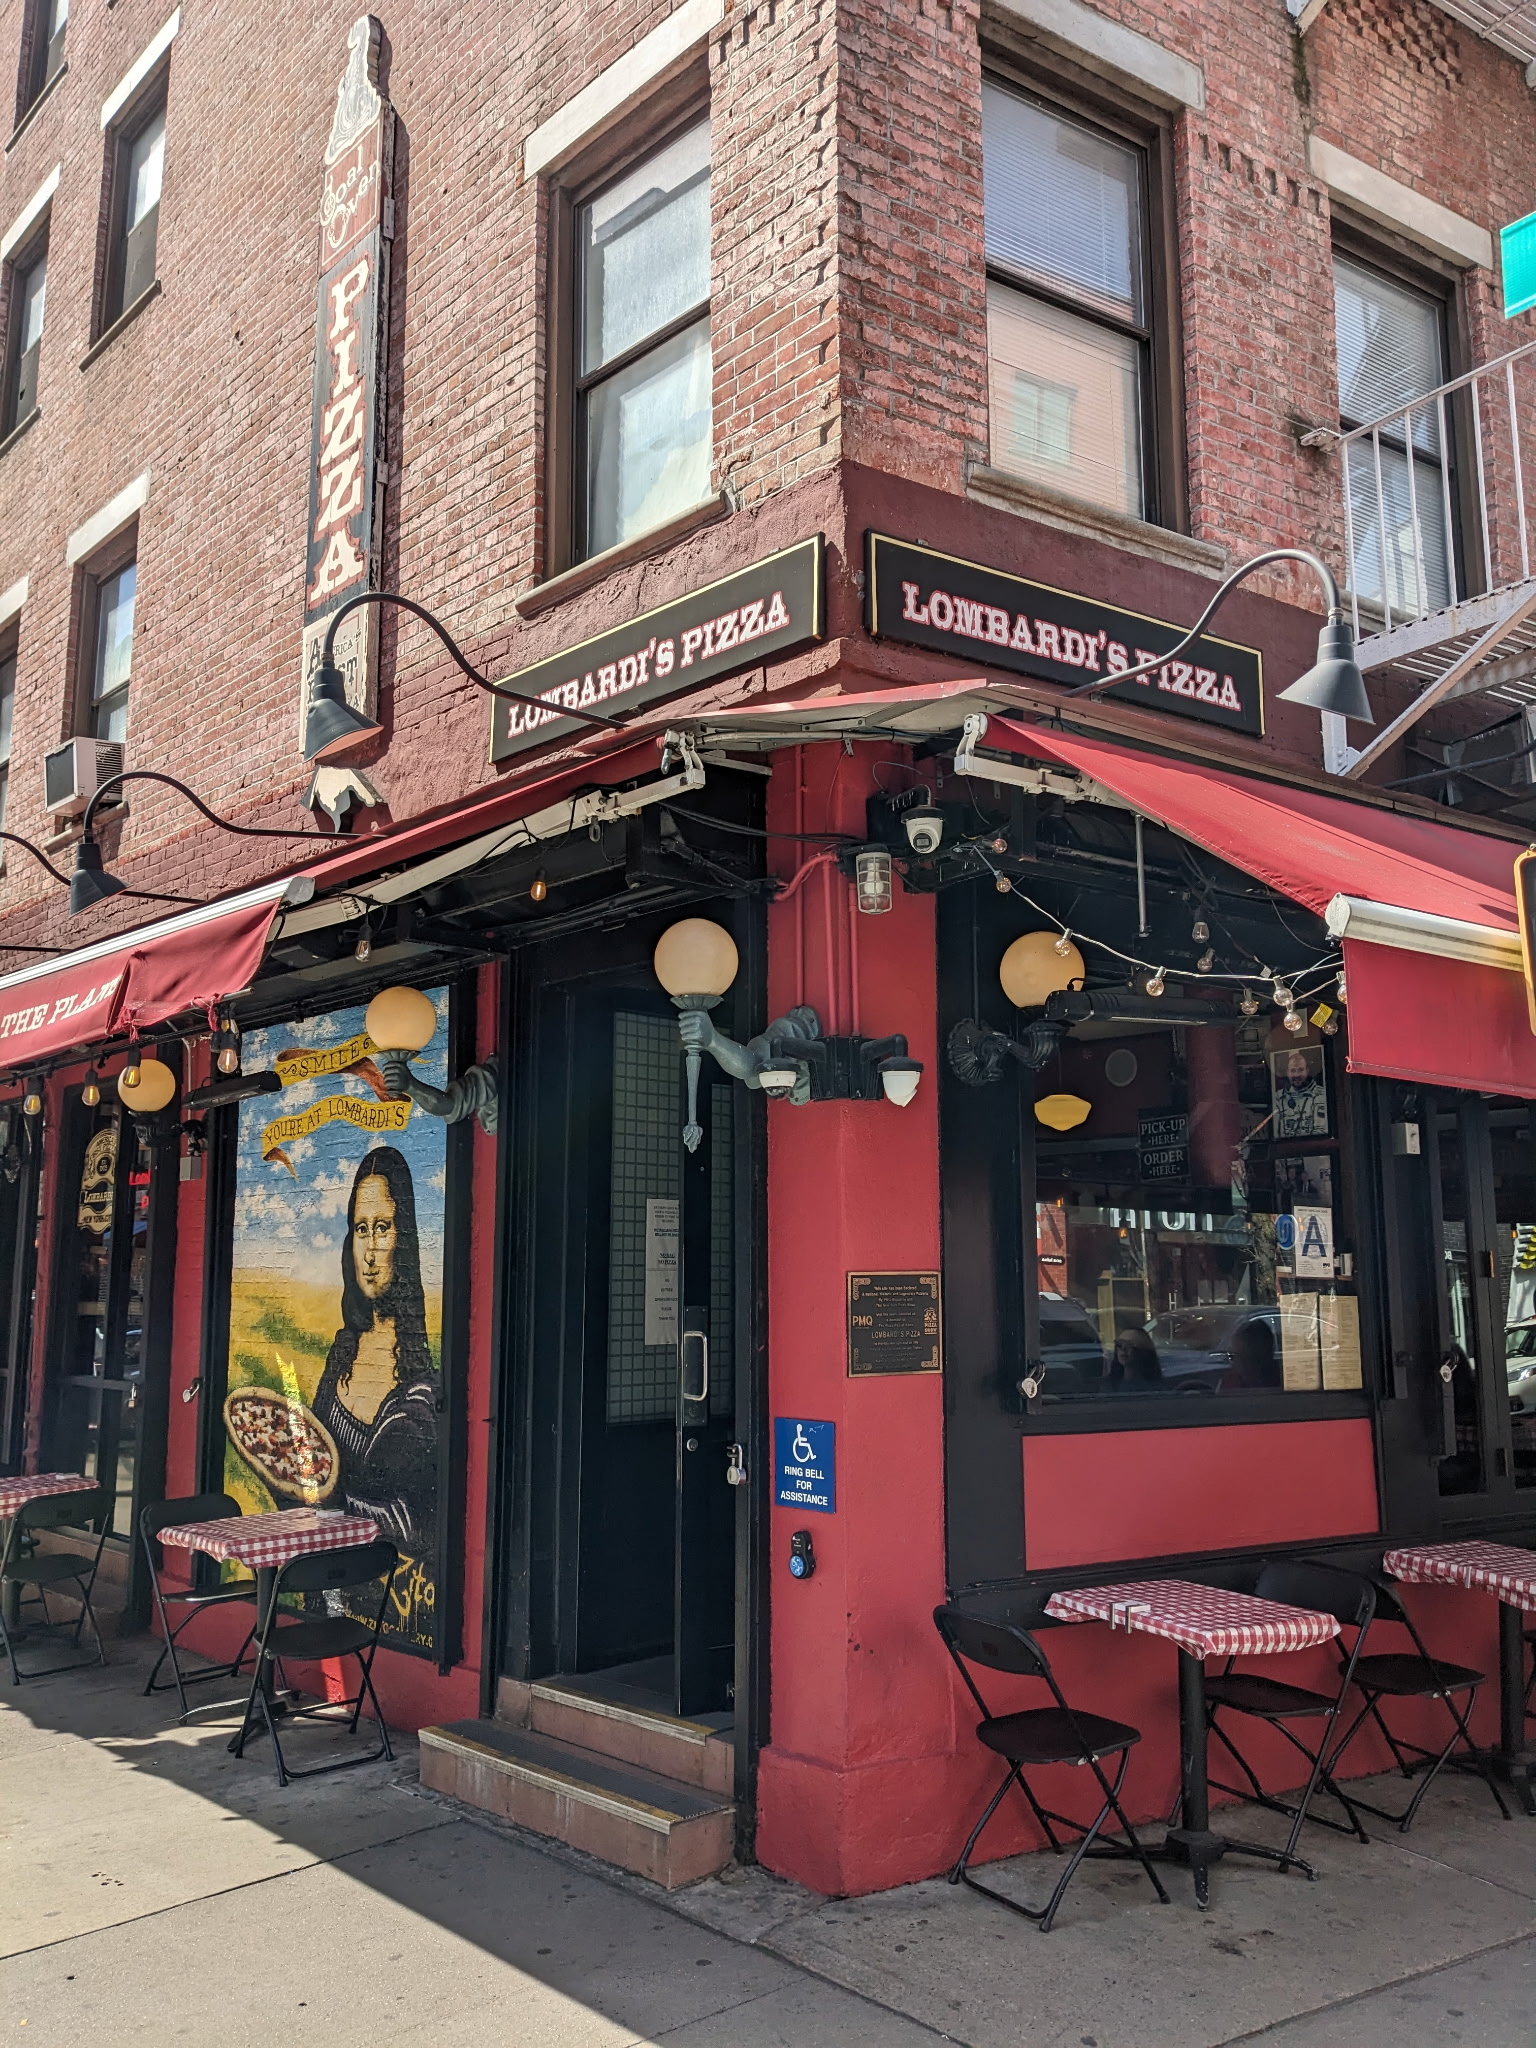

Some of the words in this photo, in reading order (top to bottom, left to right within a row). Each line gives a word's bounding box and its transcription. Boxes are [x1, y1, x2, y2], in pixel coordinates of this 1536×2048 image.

[320, 143, 363, 226] Coal
[328, 161, 381, 249] Oven
[310, 259, 370, 600] PIZZA
[903, 581, 1128, 674] LOMBARDI'S
[1136, 649, 1242, 712] PIZZA
[507, 635, 676, 739] LOMBARDI'S
[681, 590, 790, 668] PIZZA
[0, 1003, 49, 1038] THE
[300, 1041, 360, 1077] SMILE
[307, 1108, 322, 1130] AT
[328, 1099, 405, 1129] LOMBARDI'S
[1141, 1119, 1185, 1135] PICK-UP
[1144, 1150, 1184, 1165] ORDER
[1302, 1215, 1328, 1258] A
[852, 1315, 873, 1327] PMQ
[784, 1466, 803, 1477] RING
[805, 1468, 824, 1480] BELL
[796, 1479, 812, 1490] FOR
[780, 1490, 828, 1506] ASSISTANCE
